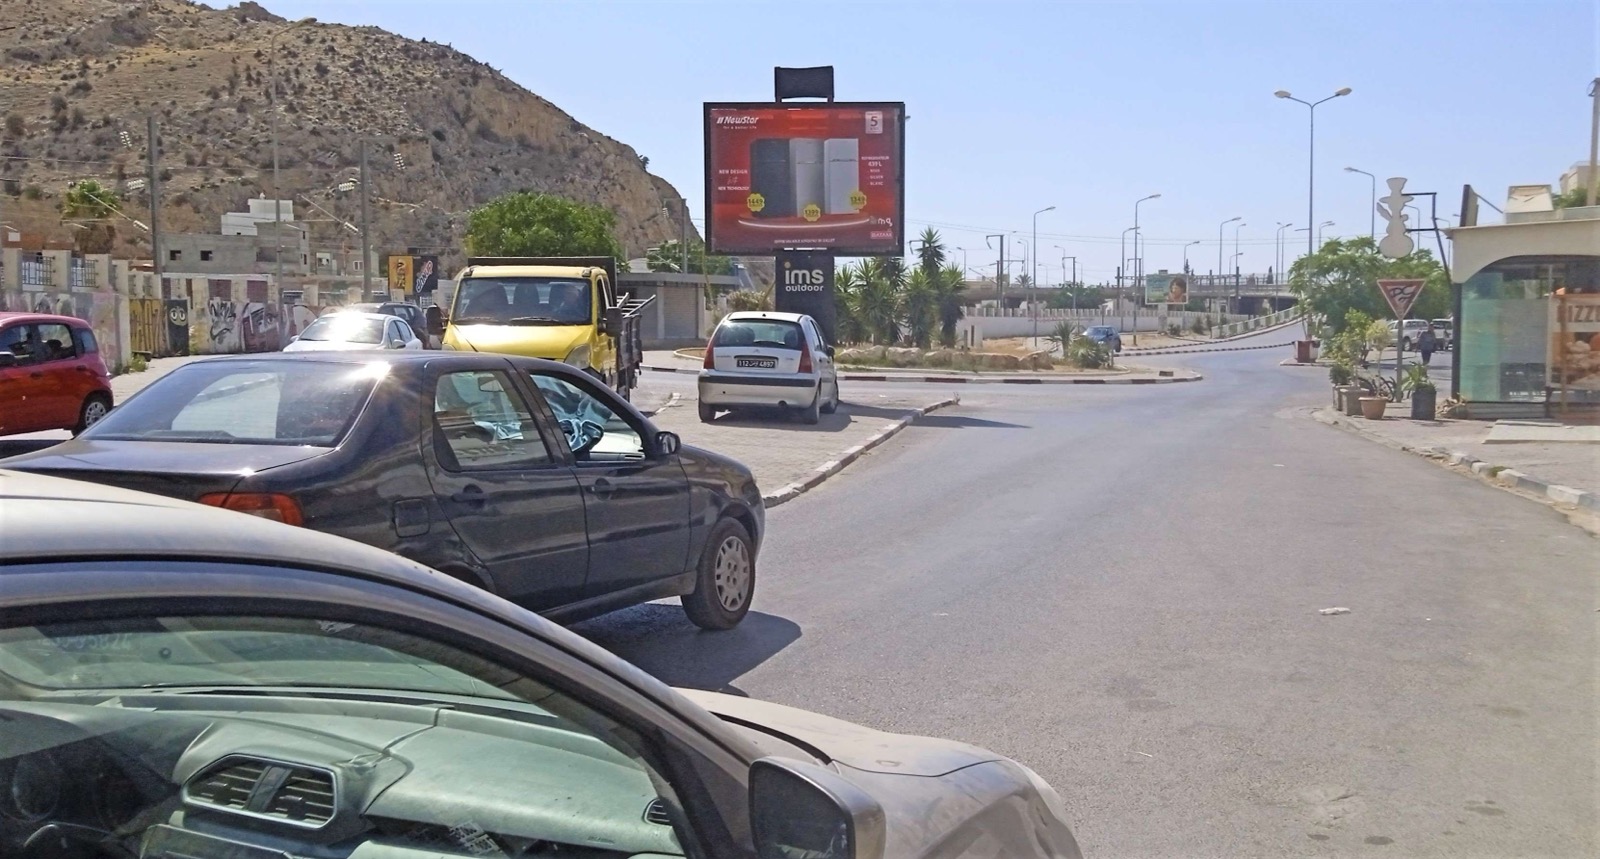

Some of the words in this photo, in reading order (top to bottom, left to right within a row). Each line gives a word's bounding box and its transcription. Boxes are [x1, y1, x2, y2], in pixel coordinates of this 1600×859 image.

[870, 116, 878, 127] 5
[784, 261, 824, 285] ims
[785, 284, 824, 292] outdoor
